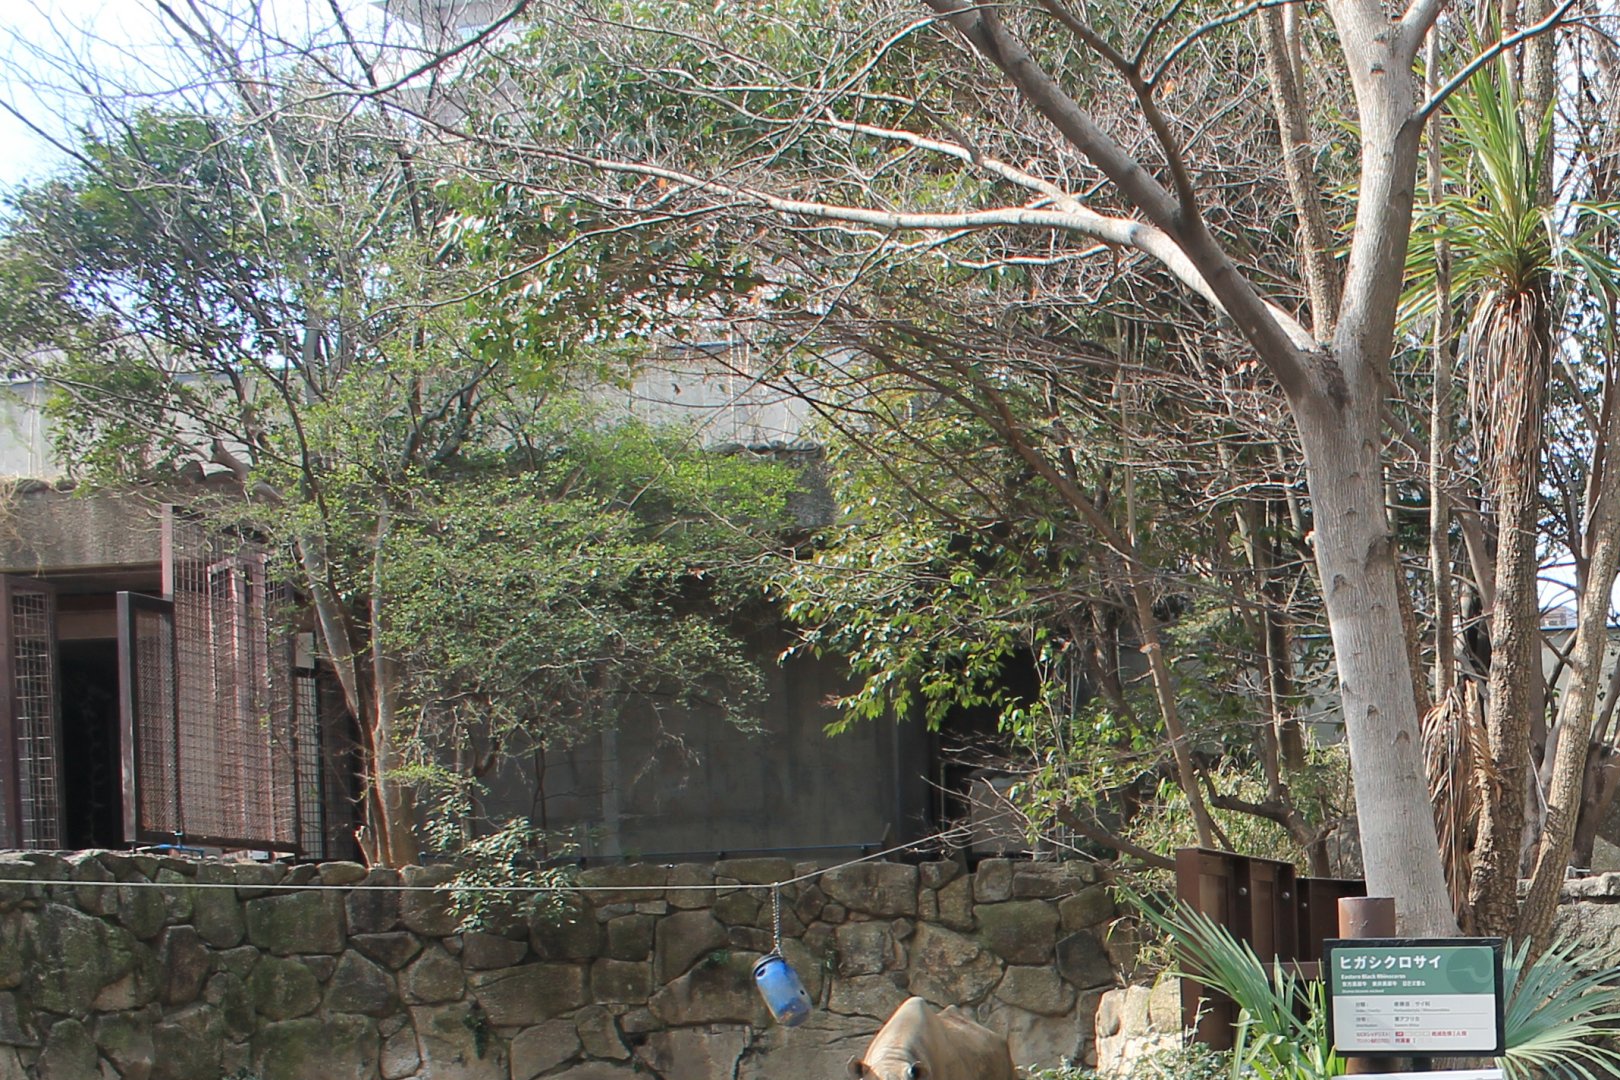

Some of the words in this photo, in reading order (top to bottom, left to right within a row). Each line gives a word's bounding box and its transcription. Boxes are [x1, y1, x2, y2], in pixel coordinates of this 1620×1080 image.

[1340, 955, 1441, 969] ヒガシクロサイ
